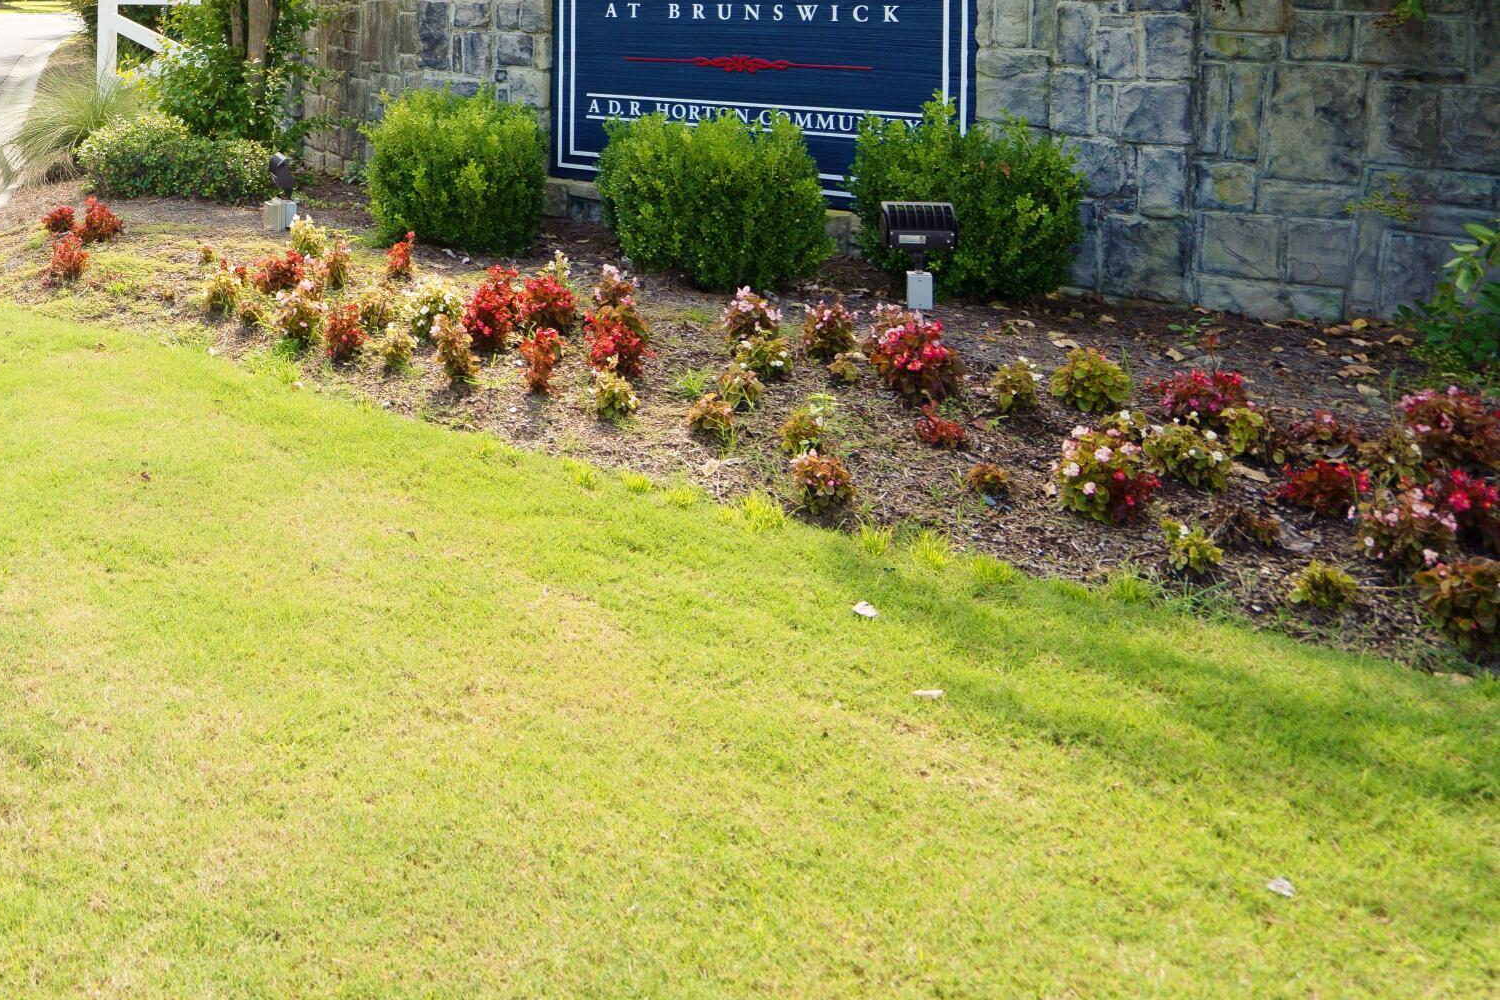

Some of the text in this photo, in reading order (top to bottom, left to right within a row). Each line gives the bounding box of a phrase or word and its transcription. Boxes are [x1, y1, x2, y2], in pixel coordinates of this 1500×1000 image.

[605, 2, 901, 23] AT BRUNSWICK
[588, 98, 600, 113] A
[608, 100, 643, 116] D.R
